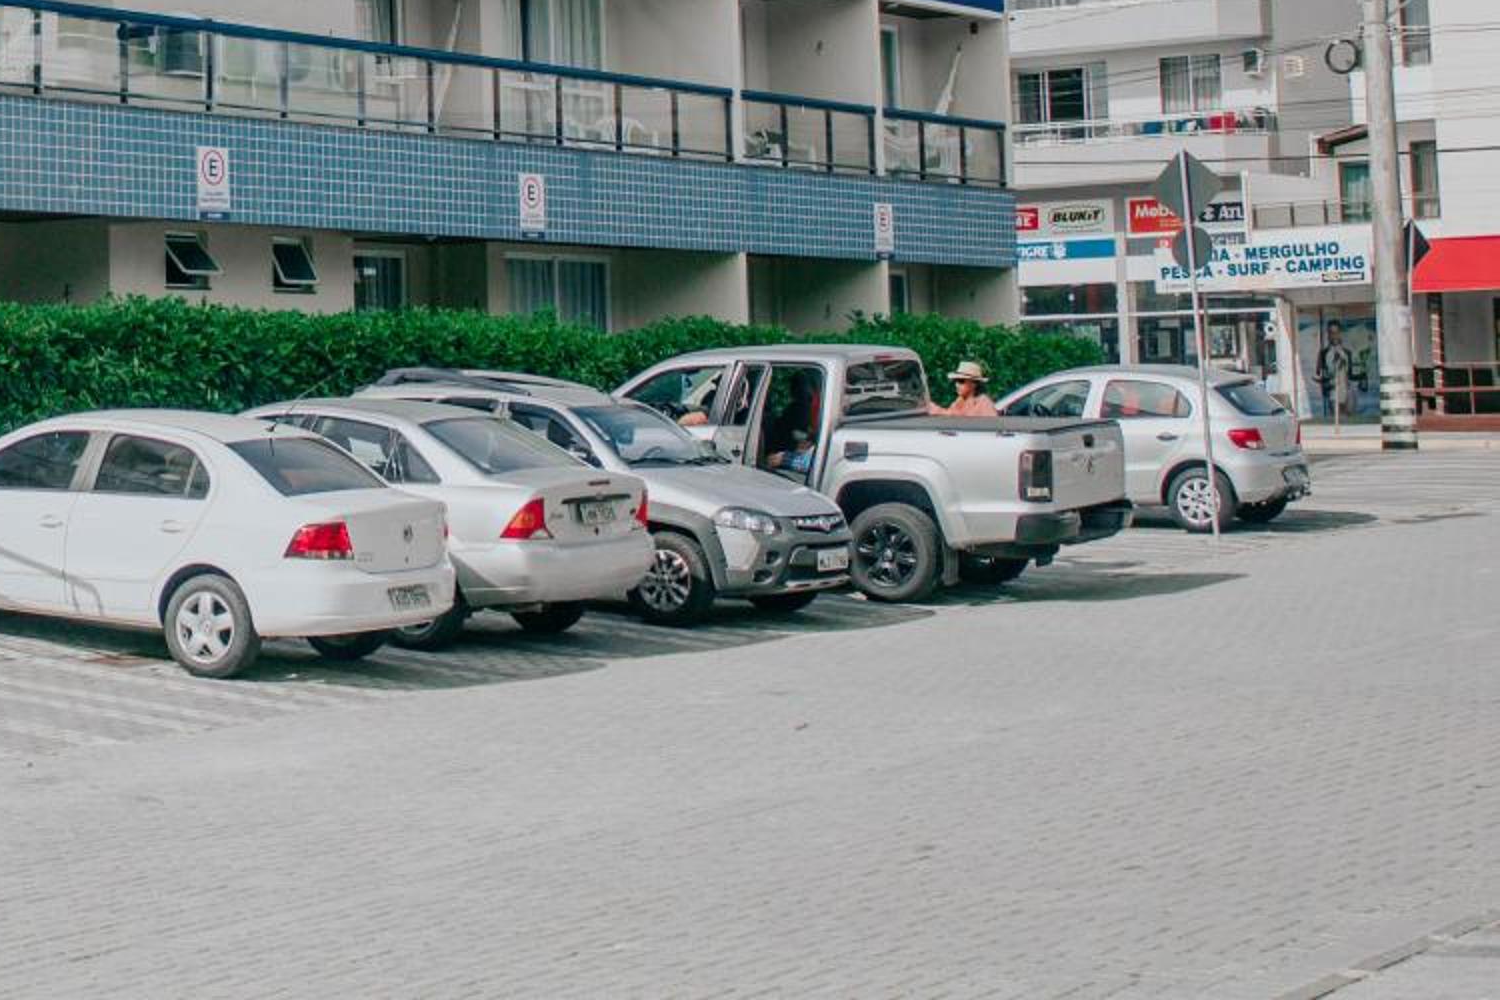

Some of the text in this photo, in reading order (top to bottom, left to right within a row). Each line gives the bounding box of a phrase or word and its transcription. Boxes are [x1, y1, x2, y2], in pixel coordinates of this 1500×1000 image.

[209, 158, 218, 177] E
[527, 184, 535, 201] E
[1244, 241, 1339, 260] MERGULHO
[1161, 265, 1213, 280] PESA
[1227, 261, 1270, 277] SURF
[1285, 255, 1365, 274] CAMPING
